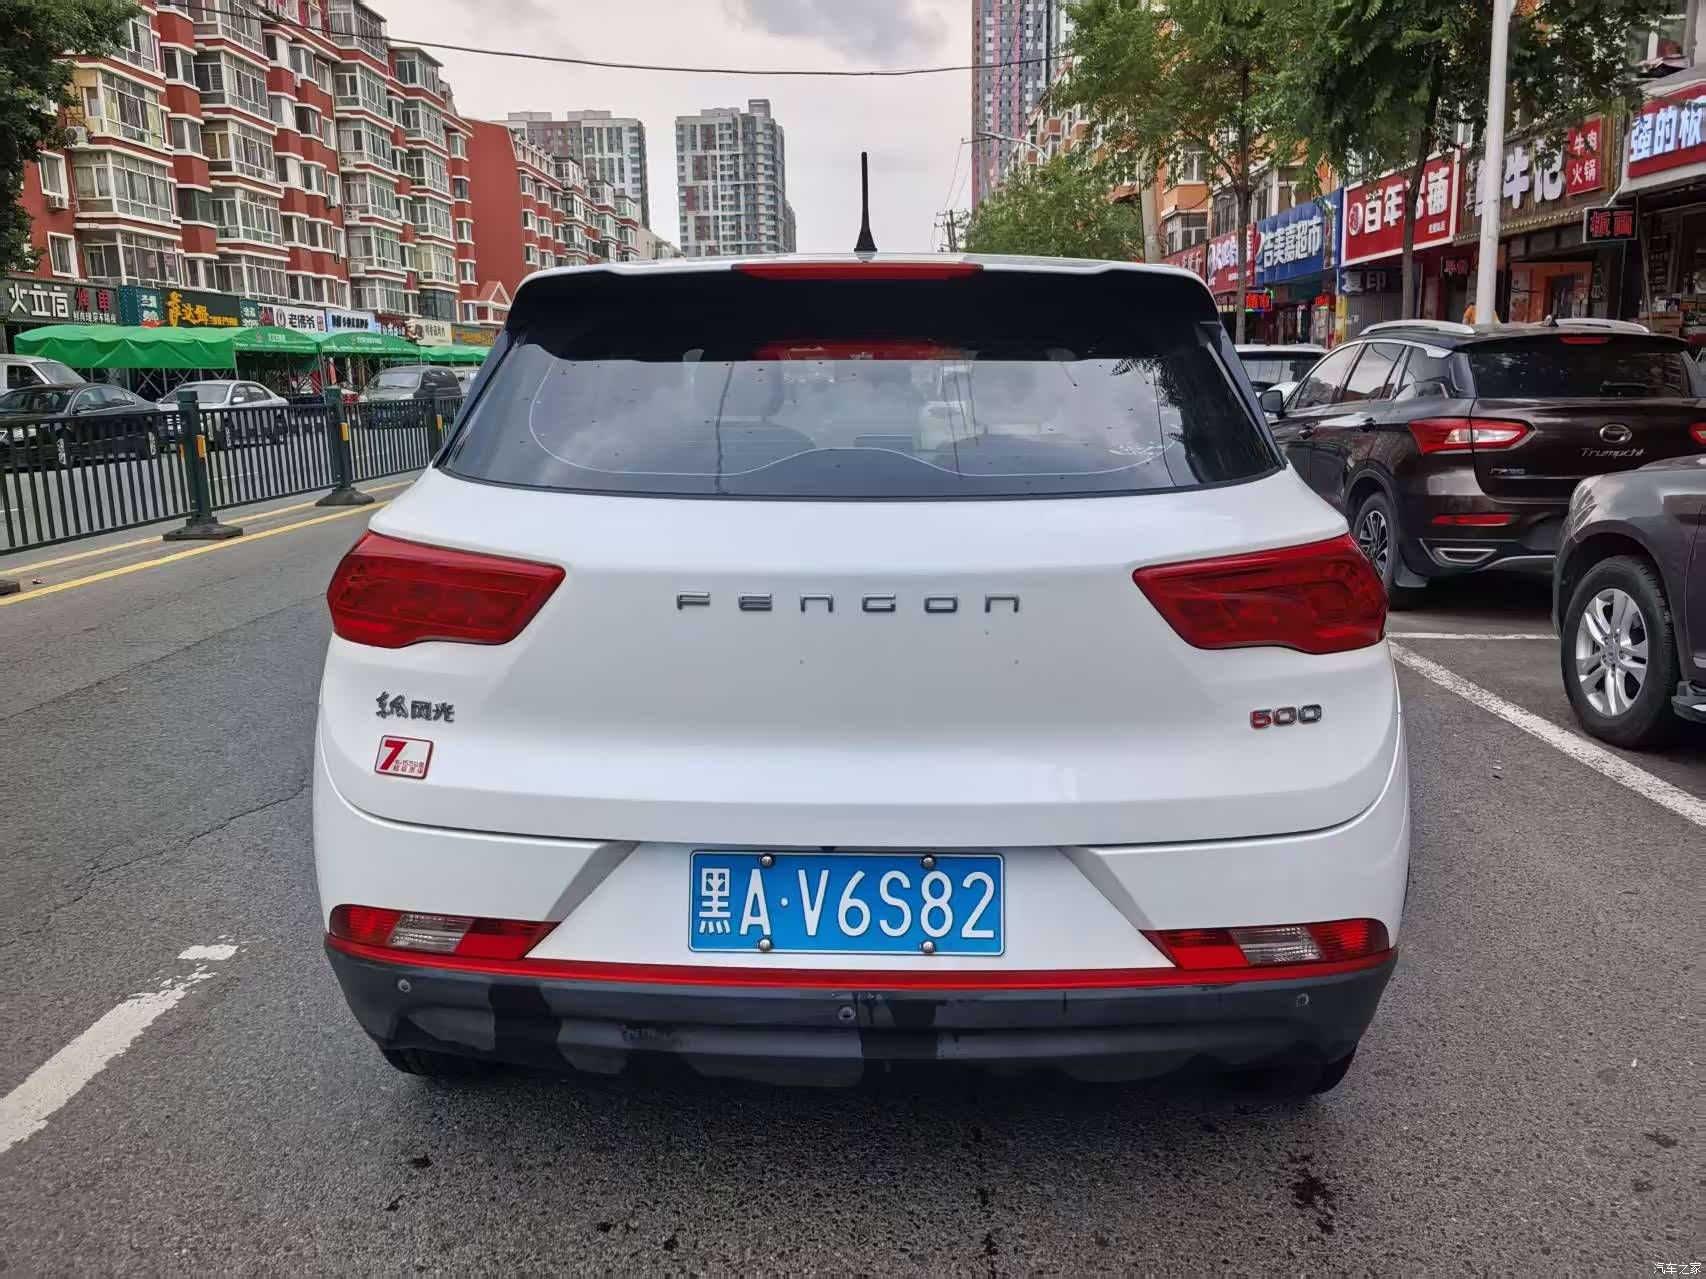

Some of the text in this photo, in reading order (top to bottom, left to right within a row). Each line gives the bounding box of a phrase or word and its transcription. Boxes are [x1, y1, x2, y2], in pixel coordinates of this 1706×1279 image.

[1573, 128, 1598, 155] 牛肉
[1571, 158, 1597, 186] 火锅
[1589, 210, 1633, 238] 板面
[1263, 215, 1323, 269] 吉美嘉超市
[1341, 270, 1386, 293] 复印
[287, 312, 316, 330] 老佛爷
[676, 590, 1020, 614] FENGON
[1249, 703, 1322, 729] 500
